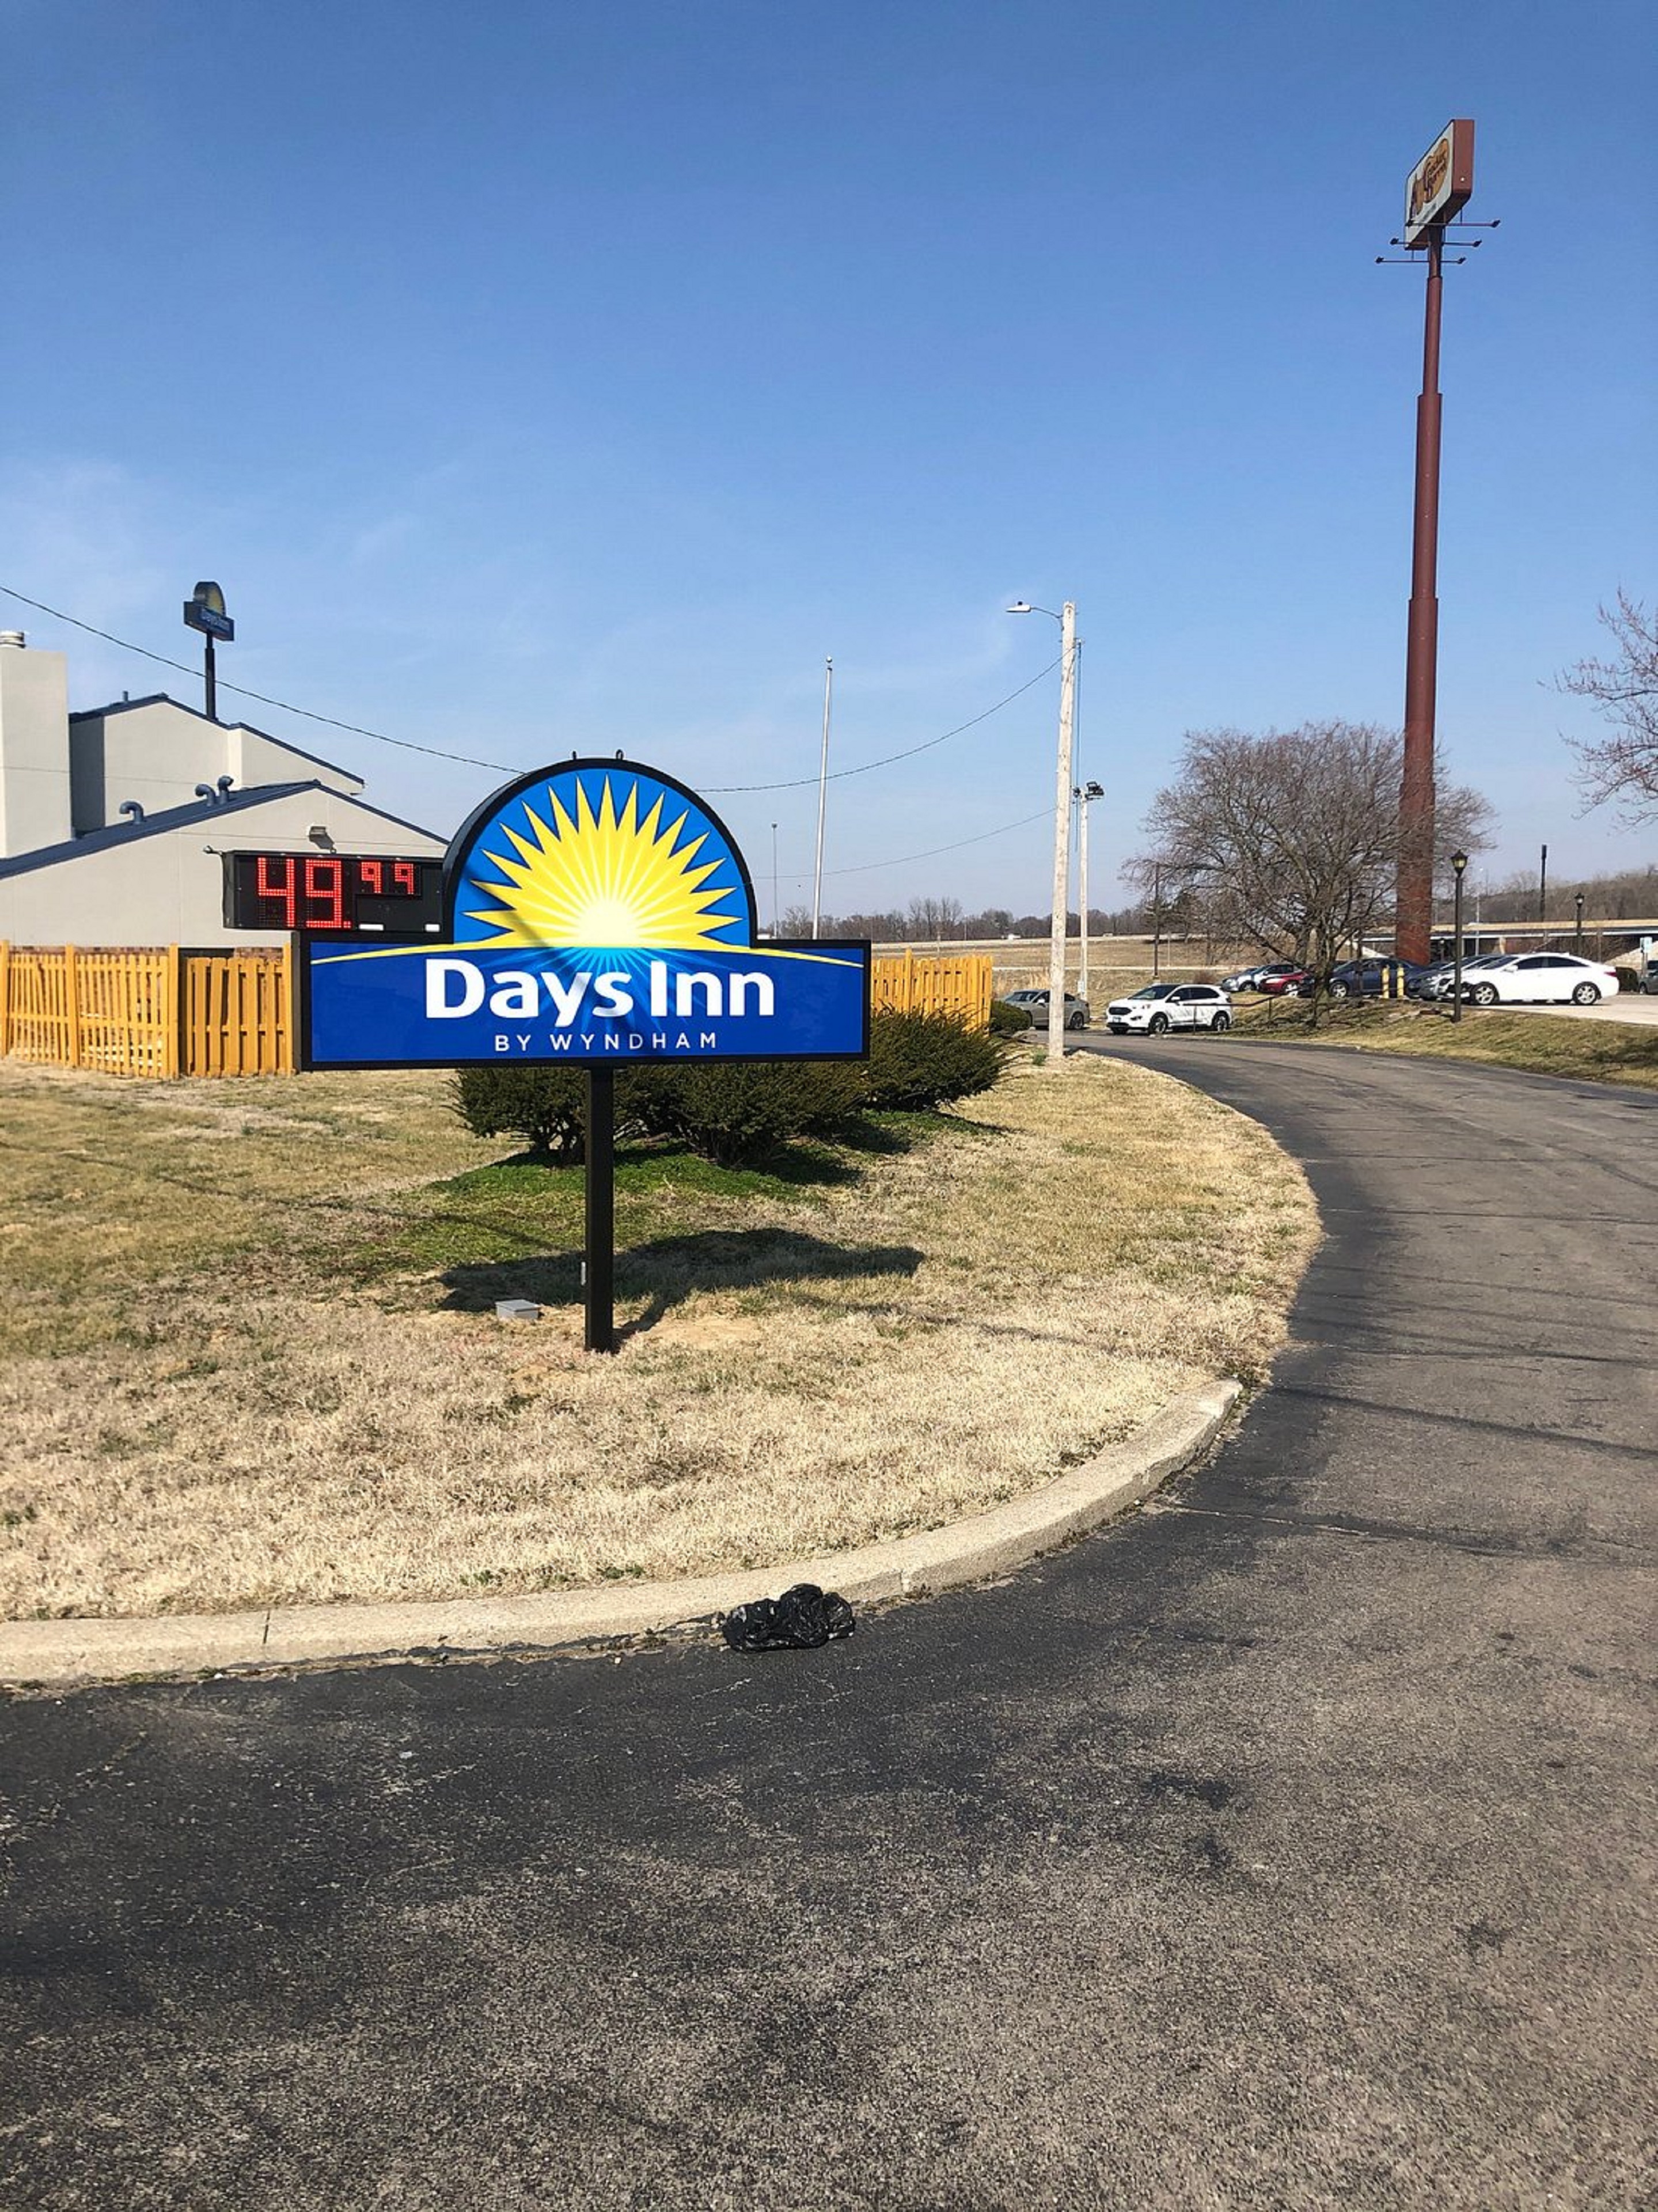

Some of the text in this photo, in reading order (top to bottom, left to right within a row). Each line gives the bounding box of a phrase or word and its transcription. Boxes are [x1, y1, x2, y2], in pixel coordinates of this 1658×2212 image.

[426, 959, 774, 1027] Days Inn
[495, 1032, 716, 1051] BY WYNDHAM
